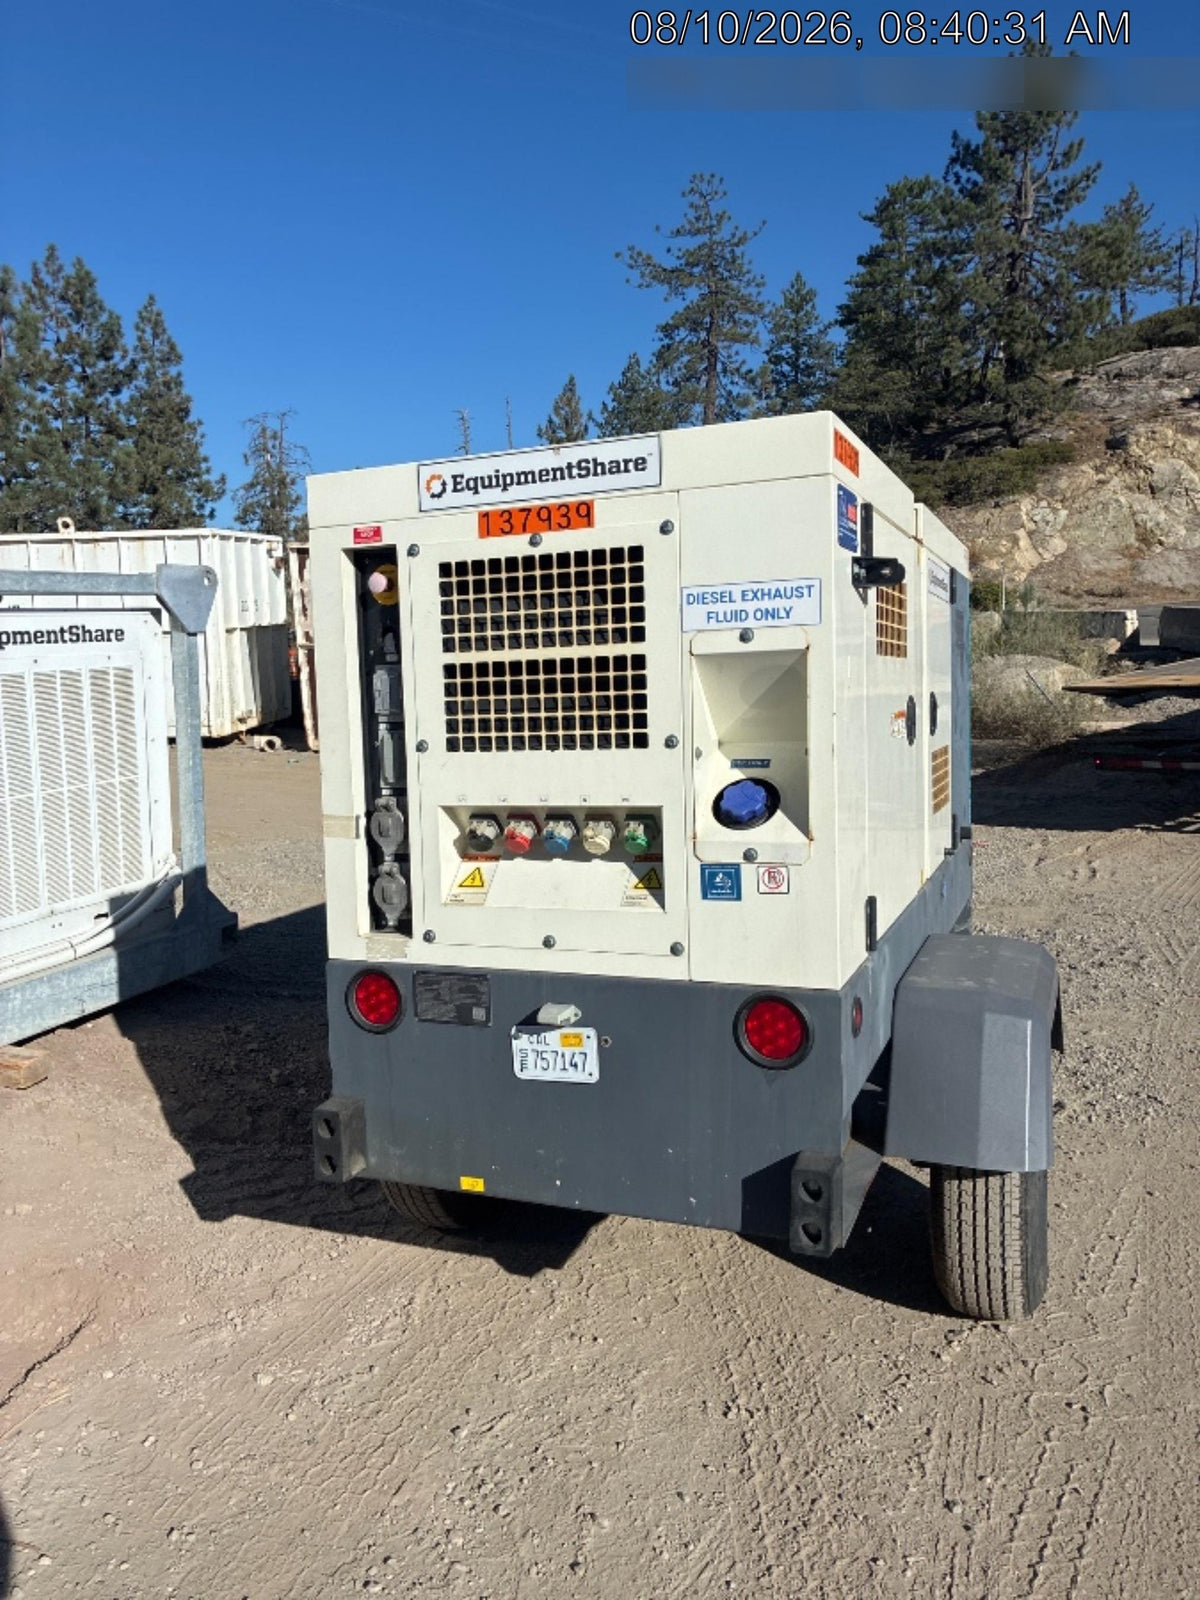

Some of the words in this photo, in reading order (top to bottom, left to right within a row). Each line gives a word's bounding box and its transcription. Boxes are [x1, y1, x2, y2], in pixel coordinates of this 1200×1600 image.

[451, 455, 648, 495] EquipmentShare
[481, 501, 592, 537] 137939
[685, 590, 736, 605] DIESEL
[741, 584, 815, 602] EXHAUST
[706, 609, 749, 624] FLUID
[753, 606, 793, 621] ONLY
[531, 1048, 588, 1073] 757147
